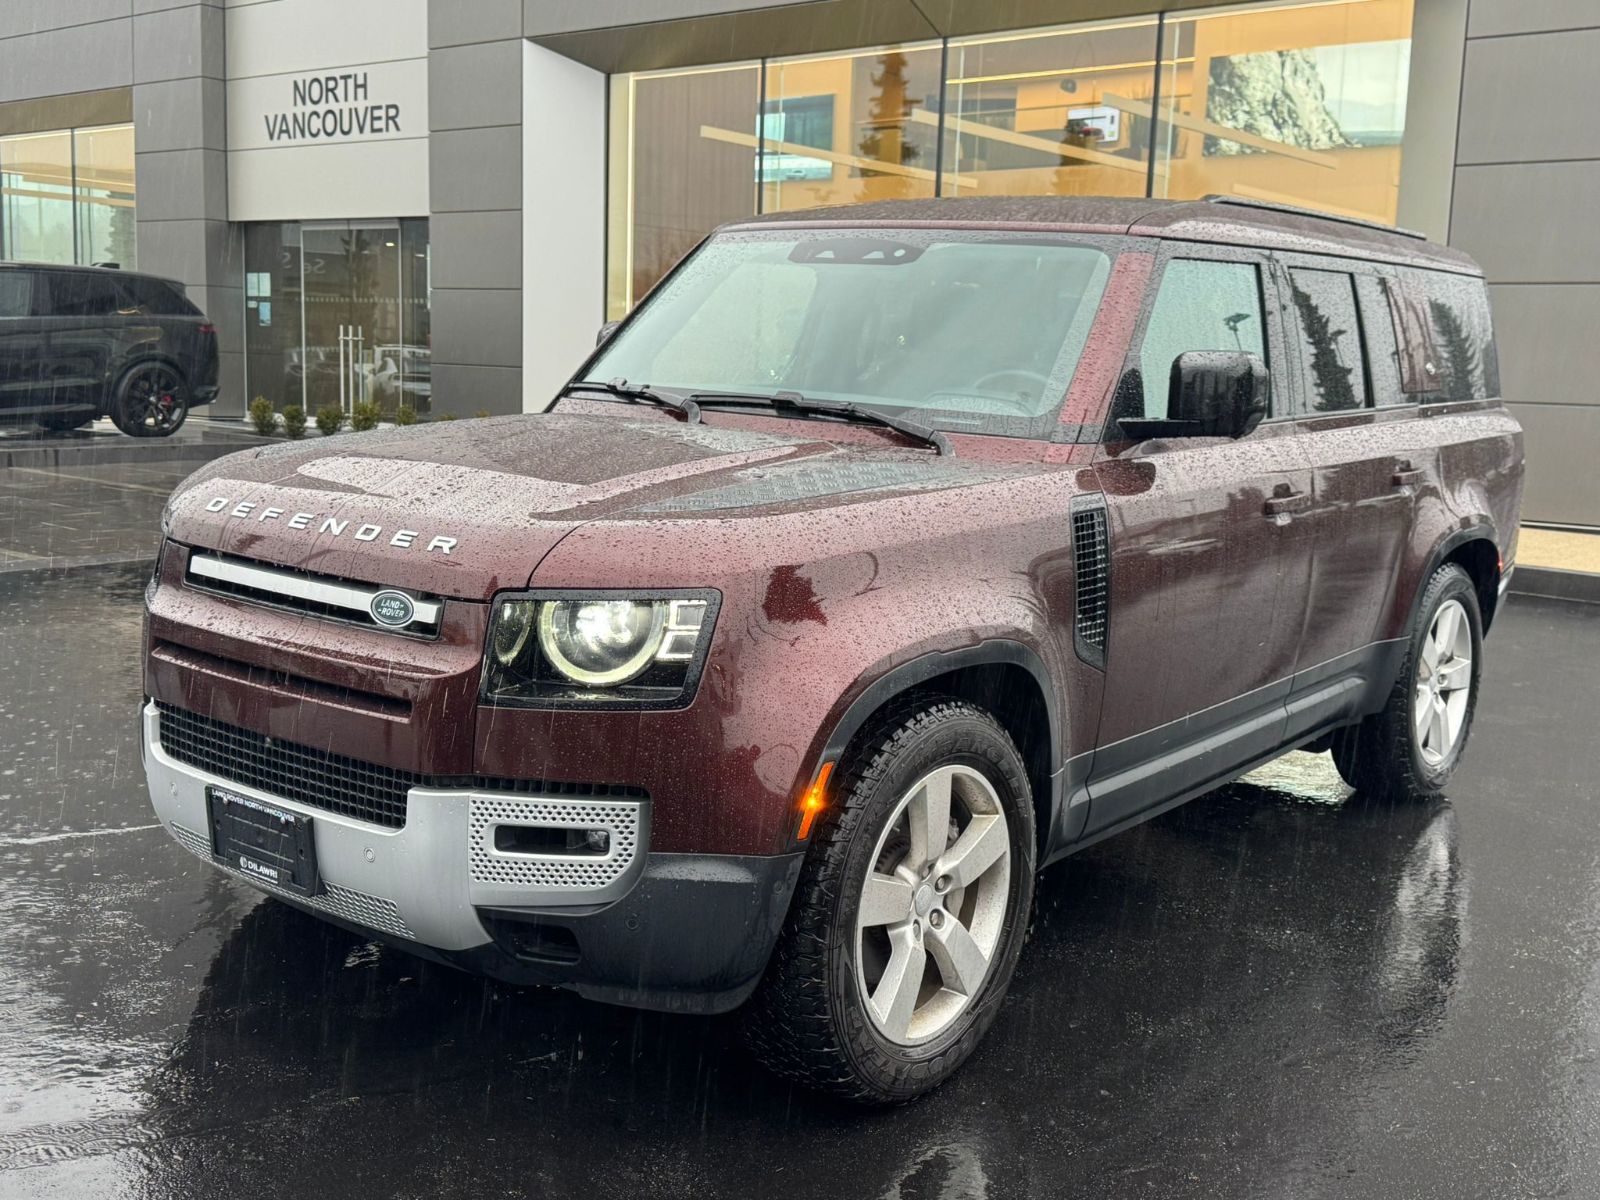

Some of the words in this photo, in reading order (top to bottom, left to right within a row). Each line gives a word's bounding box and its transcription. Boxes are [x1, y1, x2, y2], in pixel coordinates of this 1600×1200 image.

[293, 72, 368, 107] NORTH
[264, 103, 401, 141] VANCOUVER
[205, 497, 458, 554] DEFENDER
[380, 599, 401, 609] LAND
[380, 607, 405, 618] ROVER
[247, 860, 278, 879] DILAWRI
